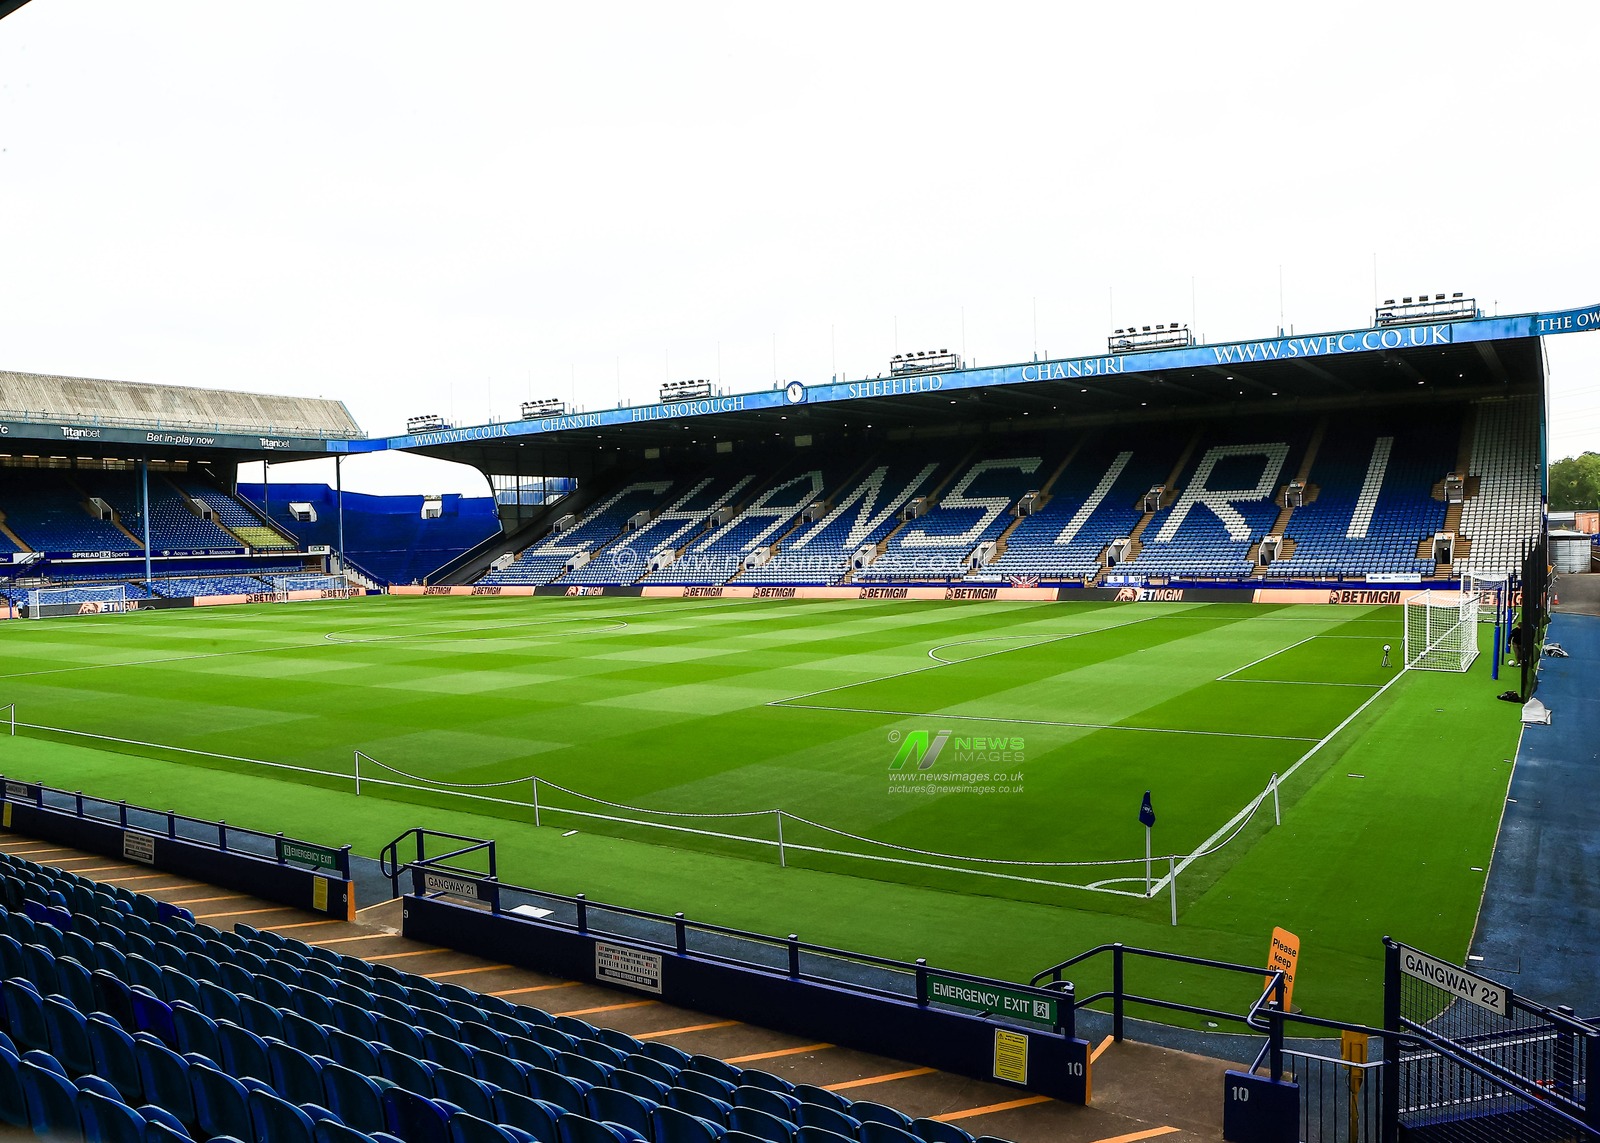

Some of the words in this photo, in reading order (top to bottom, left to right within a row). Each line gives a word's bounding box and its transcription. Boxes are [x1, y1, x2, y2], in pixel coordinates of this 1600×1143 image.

[1537, 316, 1573, 332] THE
[1213, 324, 1451, 365] WWW.SWFC.CO.UK
[1020, 356, 1126, 384] CHANSIRI
[847, 374, 943, 399] SHEFFIELD
[630, 396, 746, 422] HILLSBOROUGH
[540, 413, 603, 433] CHANSIRI
[61, 426, 101, 438] Titanbet
[146, 432, 163, 442] Bet
[164, 435, 196, 446] in-play
[413, 424, 511, 448] WWW.SWFC.CO.UK
[259, 437, 290, 447] Titanbet
[111, 551, 130, 559] Sports
[428, 586, 452, 595] BETMGM
[475, 586, 502, 595] BETMGM
[689, 587, 723, 597] BETMGM
[760, 587, 796, 598] BETMGM
[867, 588, 908, 599] BETMGM
[954, 588, 998, 599] BETMGM
[1138, 589, 1184, 602] ETMGM
[1341, 590, 1401, 604] BETMGM
[428, 877, 465, 893] GANGWAY
[466, 884, 474, 895] 21
[1272, 937, 1297, 958] Please
[1274, 952, 1292, 970] keep
[1405, 954, 1478, 998] GANGWAY
[1480, 987, 1499, 1008] 22
[933, 982, 1001, 1007] EMERGENCY
[1003, 996, 1030, 1013] EXIT
[1067, 1062, 1083, 1077] 10
[1232, 1086, 1249, 1102] 10
